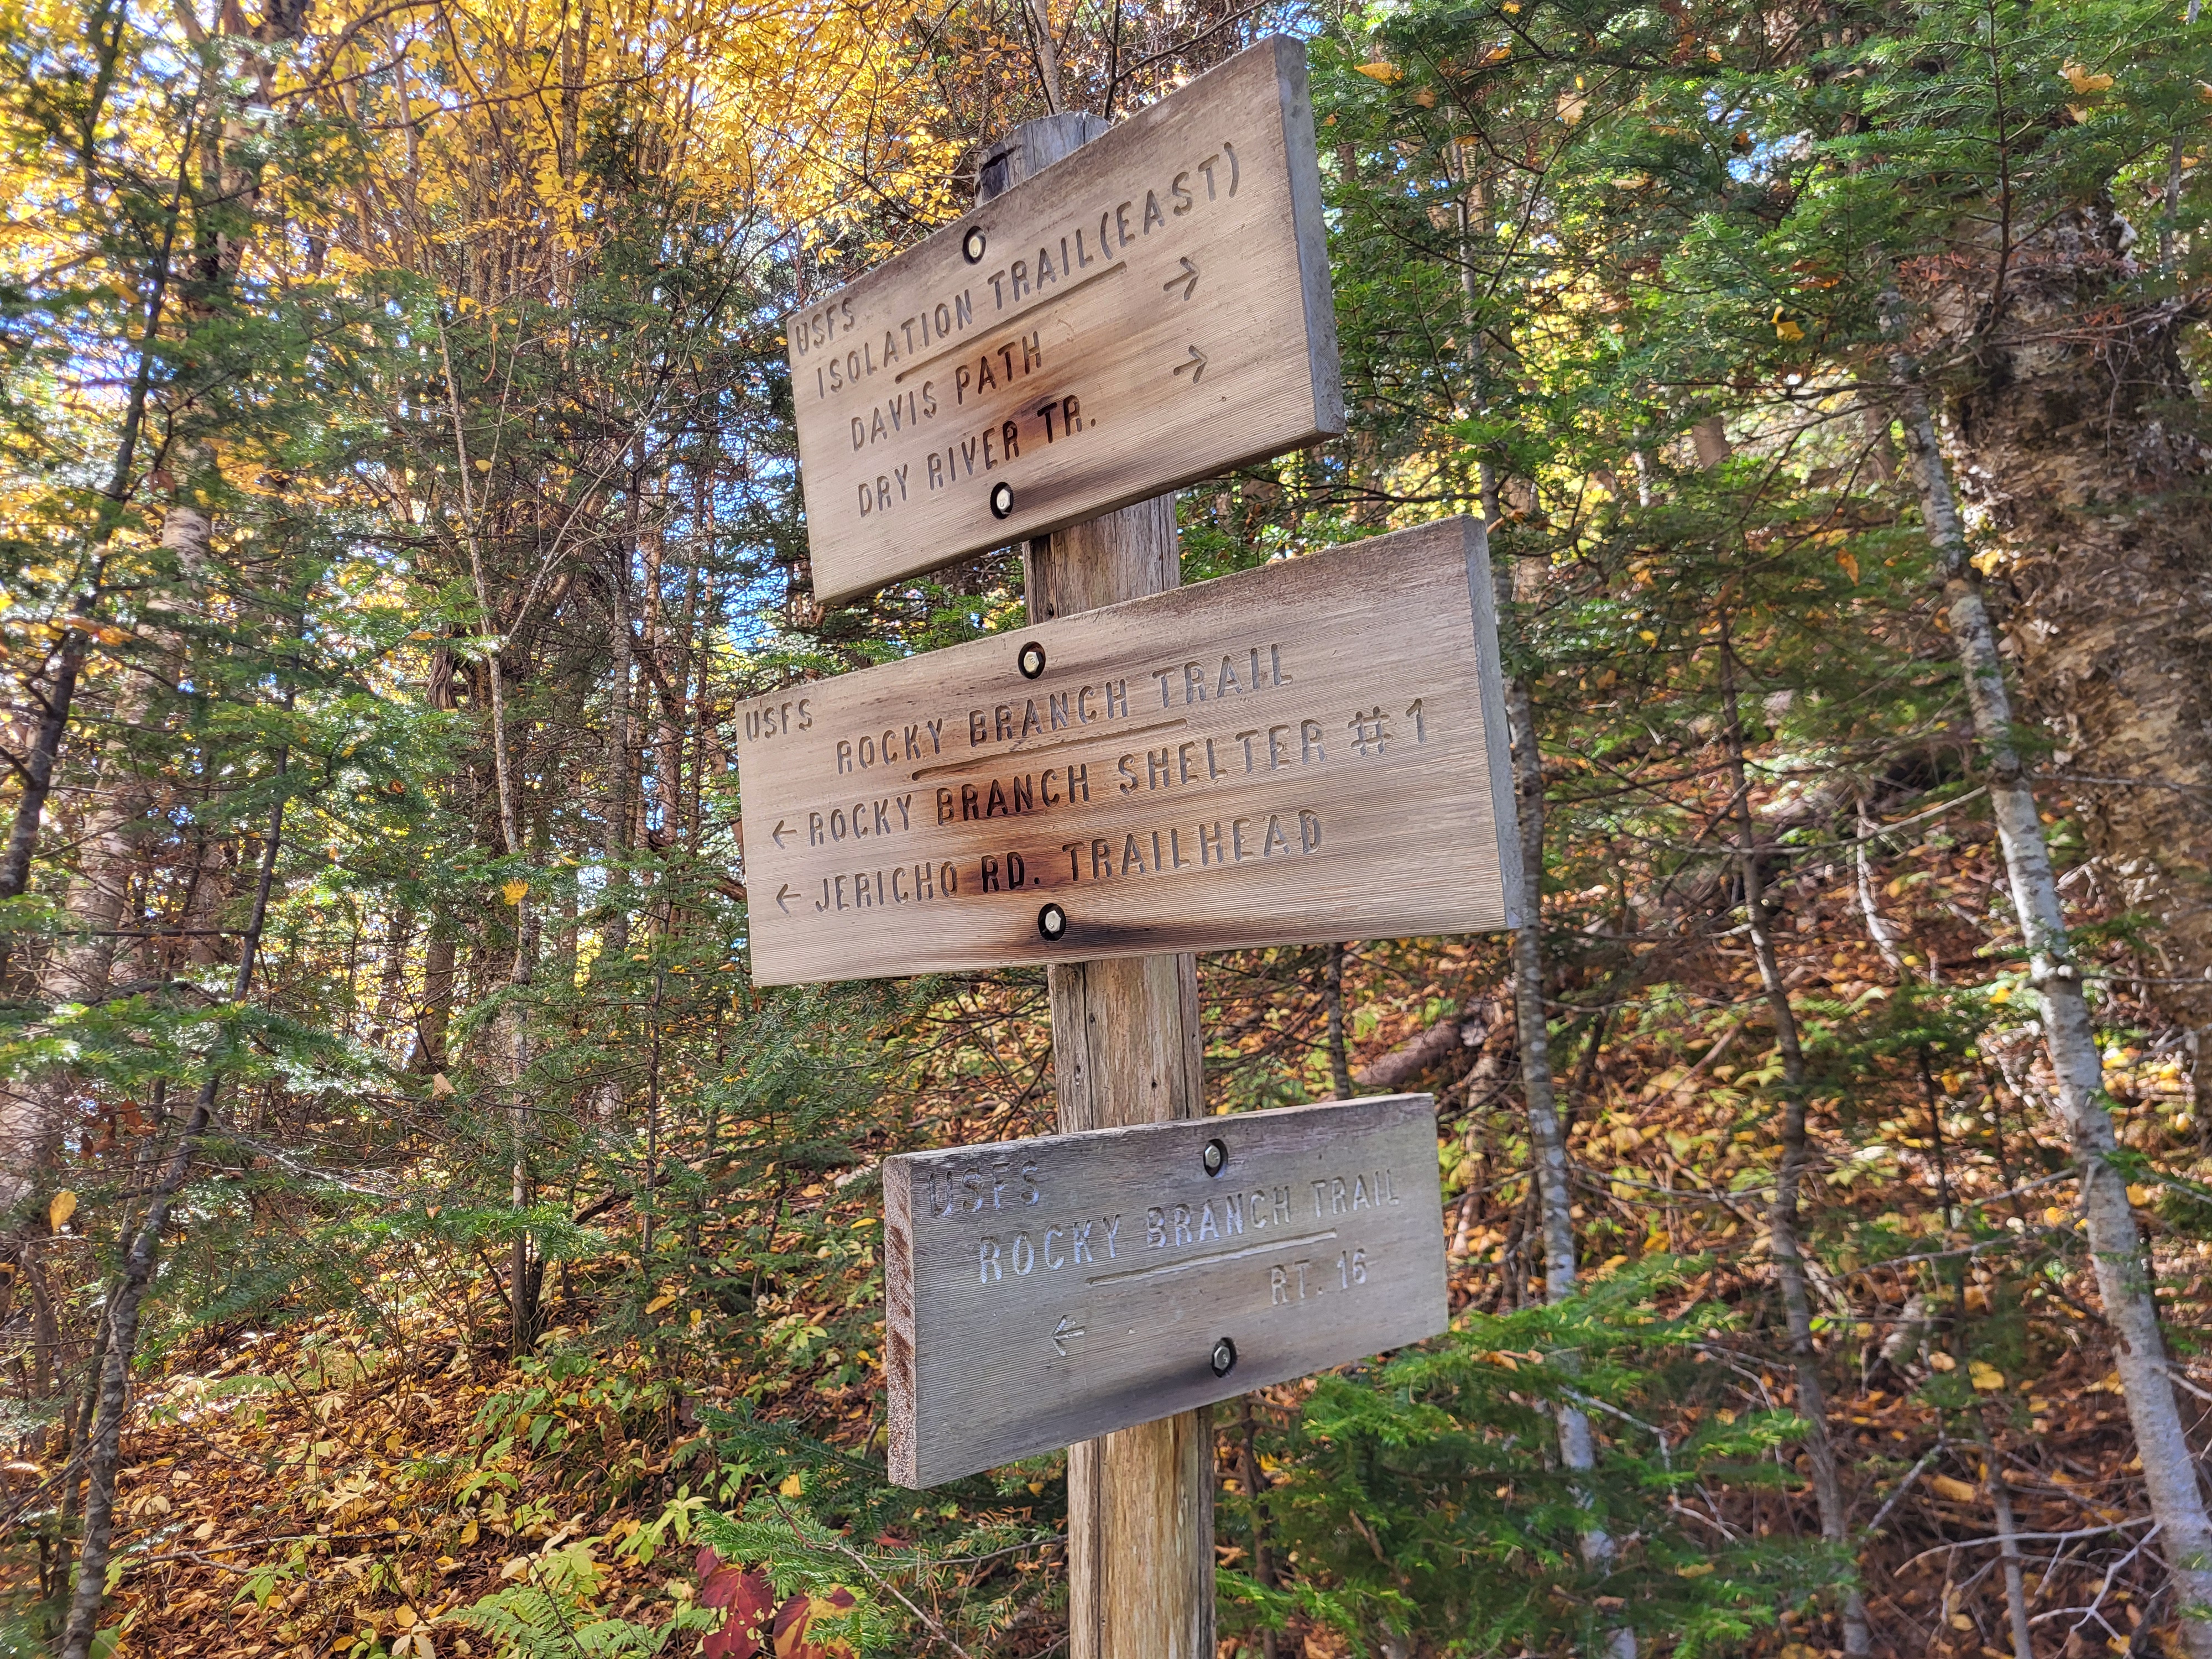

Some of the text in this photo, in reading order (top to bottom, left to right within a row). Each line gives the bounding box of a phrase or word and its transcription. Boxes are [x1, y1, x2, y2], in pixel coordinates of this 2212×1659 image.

[796, 298, 856, 357] USFS
[816, 289, 973, 399] ISOLATION
[851, 332, 1041, 452] DAVIS PATH
[859, 395, 1096, 517] DRY RIVER TR.
[746, 698, 812, 743] USFS
[837, 644, 1293, 774] ROCKY BRANCH TRAIL
[810, 794, 911, 847] ROCKY
[937, 764, 1089, 826] BRANCH
[1118, 719, 1326, 794] SHELTER
[816, 809, 1322, 912] JERICHO RD. TRAILHEAD
[929, 1160, 1040, 1217] USFS
[979, 1169, 1399, 1284] ROCKY BRANCH TRAIL
[1271, 1248, 1367, 1305] RT. 16
